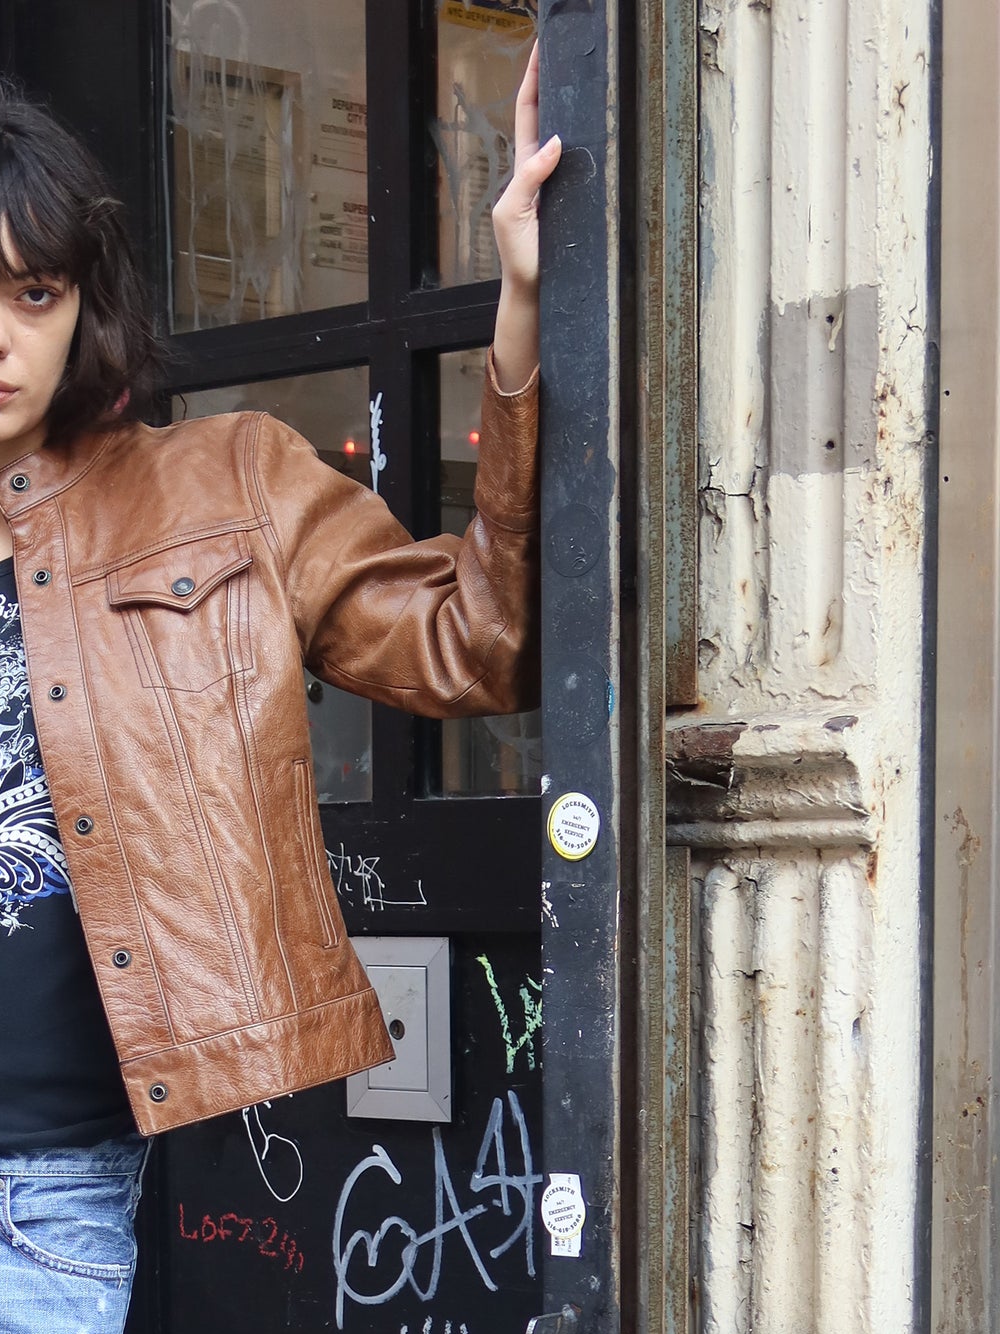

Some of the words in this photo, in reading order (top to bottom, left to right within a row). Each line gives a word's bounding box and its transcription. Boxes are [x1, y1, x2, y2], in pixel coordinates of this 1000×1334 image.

[562, 800, 595, 818] LOCKSMITH
[561, 820, 590, 832] EMERGENCY
[564, 829, 584, 839] SERVICE
[544, 1186, 575, 1202] LOCKSMITH
[548, 1205, 576, 1215] EMERGENCY
[554, 1214, 573, 1222] SERVICE
